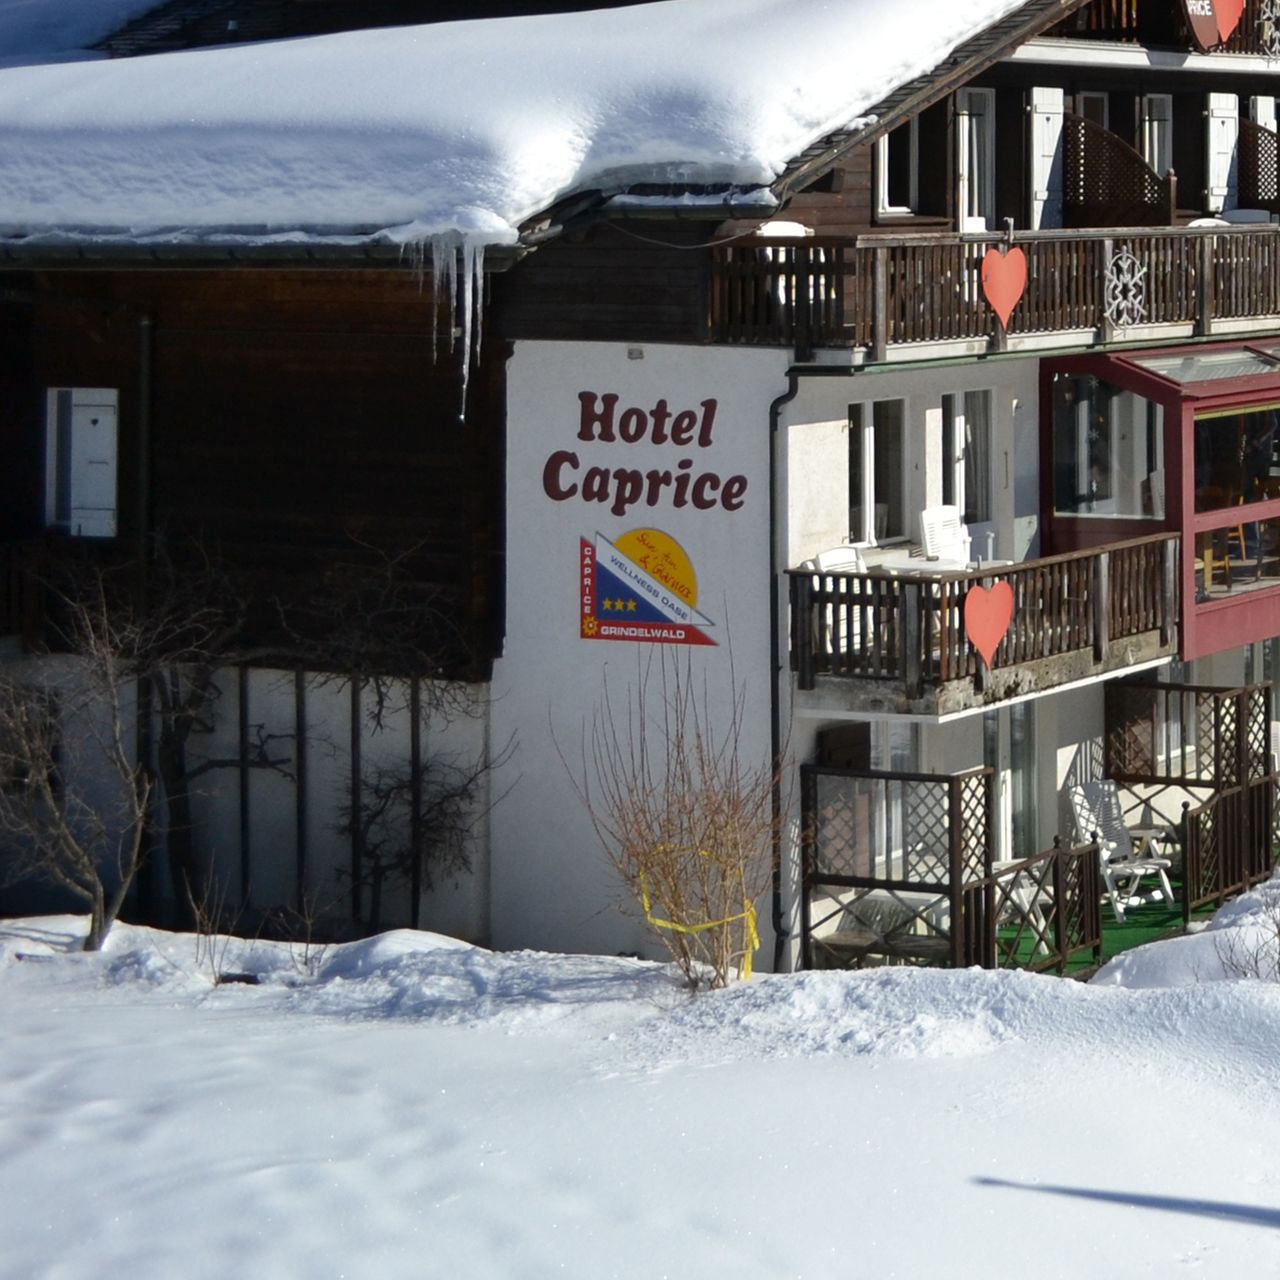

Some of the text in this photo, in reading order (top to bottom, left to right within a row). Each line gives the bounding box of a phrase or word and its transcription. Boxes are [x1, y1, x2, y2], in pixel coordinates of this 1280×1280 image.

[577, 391, 717, 447] Hotel
[542, 450, 747, 516] Caprice
[583, 547, 592, 614] CAPRICE
[610, 555, 688, 620] WELLNESS OASE
[601, 626, 685, 638] GRINDELWALD
